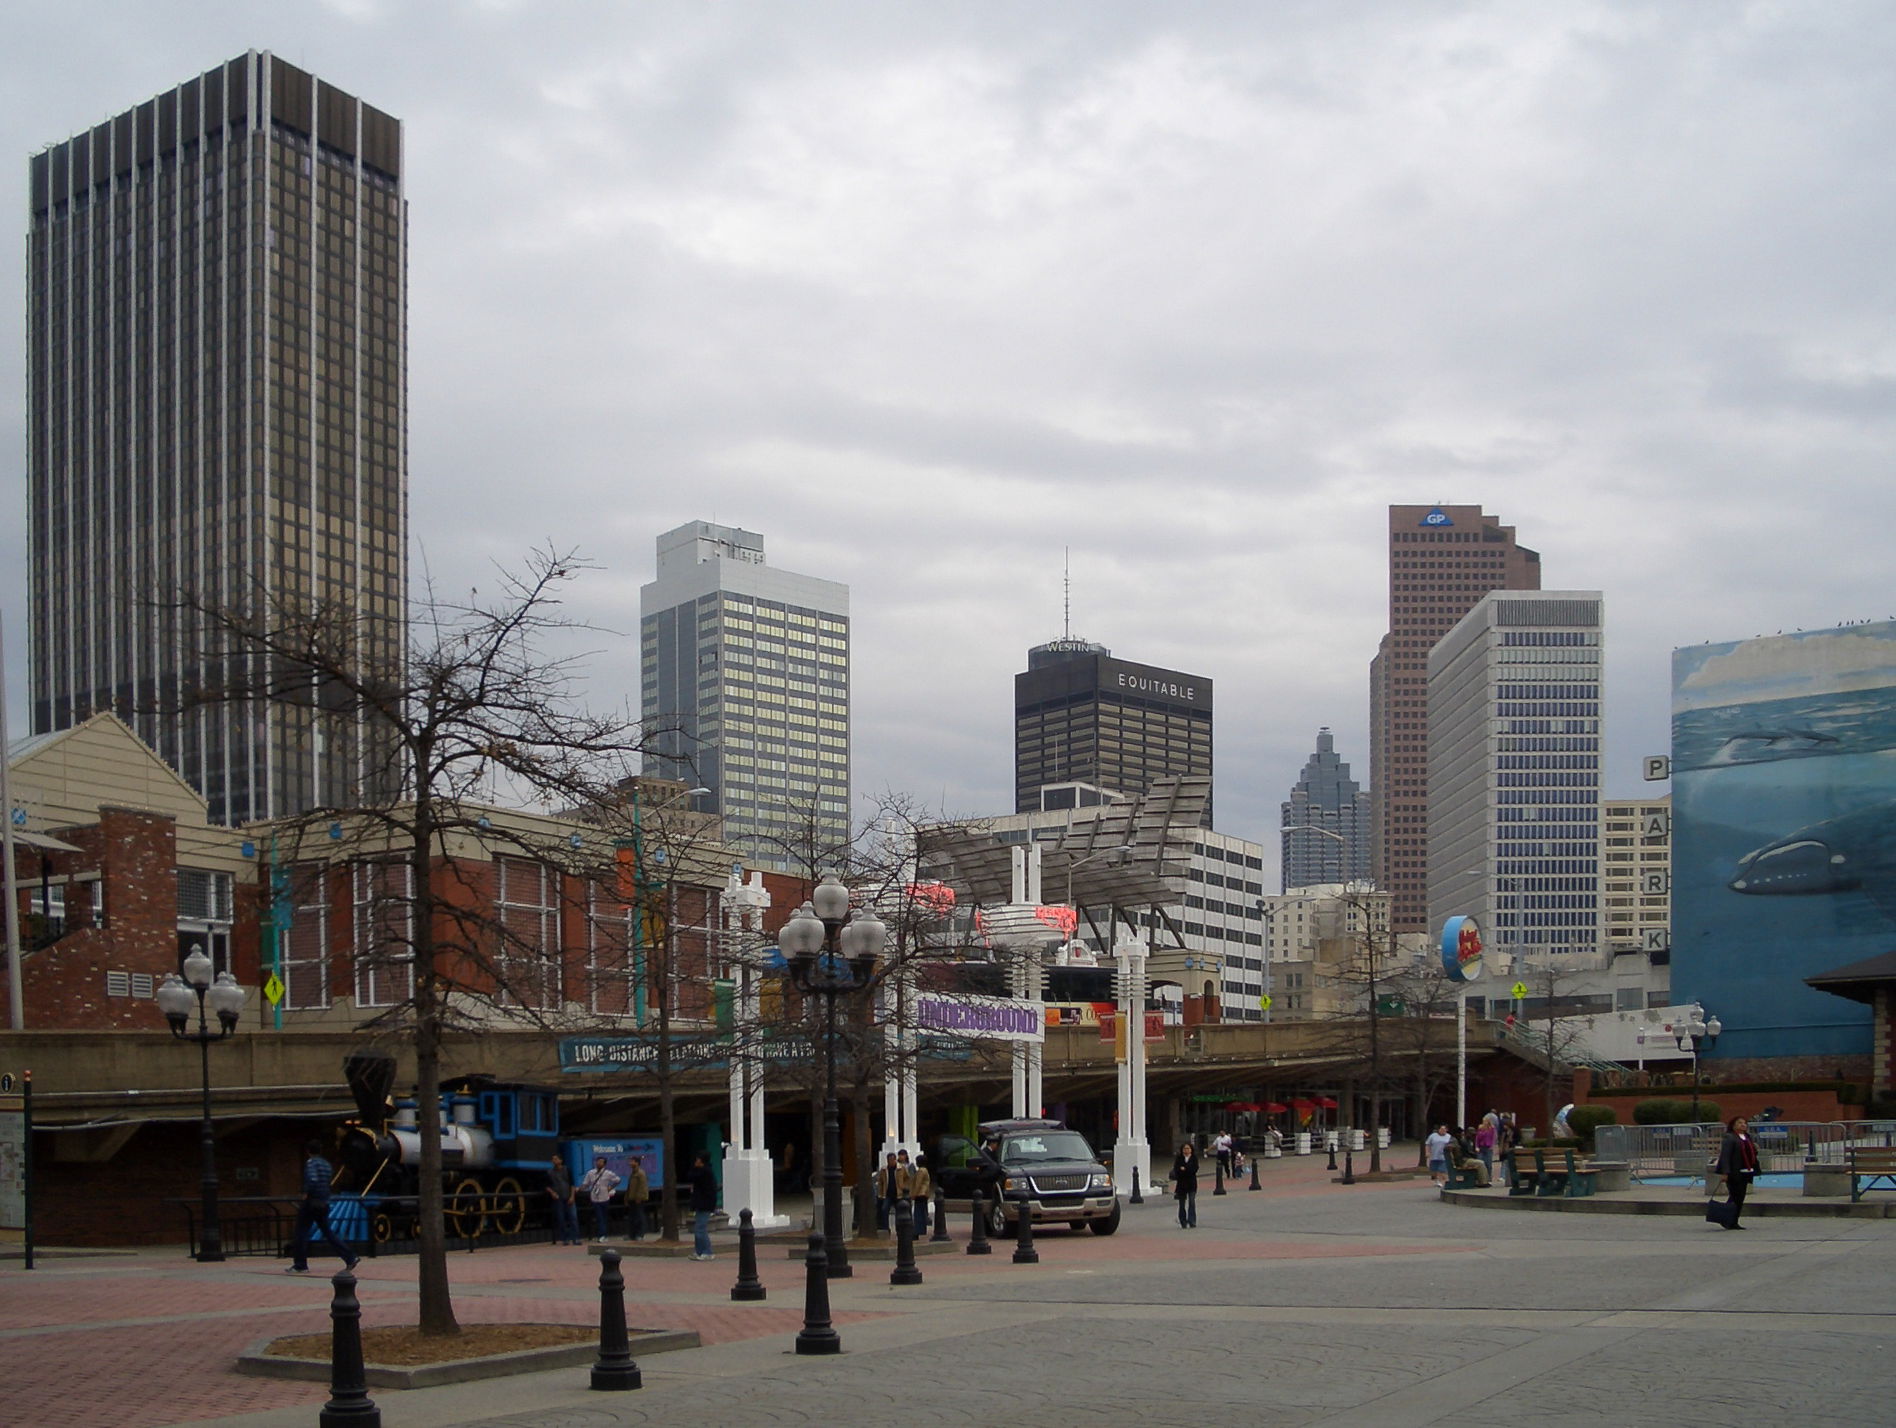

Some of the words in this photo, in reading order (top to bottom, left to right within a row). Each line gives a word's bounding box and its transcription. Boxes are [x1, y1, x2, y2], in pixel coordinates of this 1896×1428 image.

[1427, 514, 1446, 524] GP
[1047, 642, 1089, 652] WESTIN
[1118, 673, 1194, 700] EQUITABLE
[1648, 760, 1663, 948] PARK
[918, 997, 1038, 1034] UNDERGROUND
